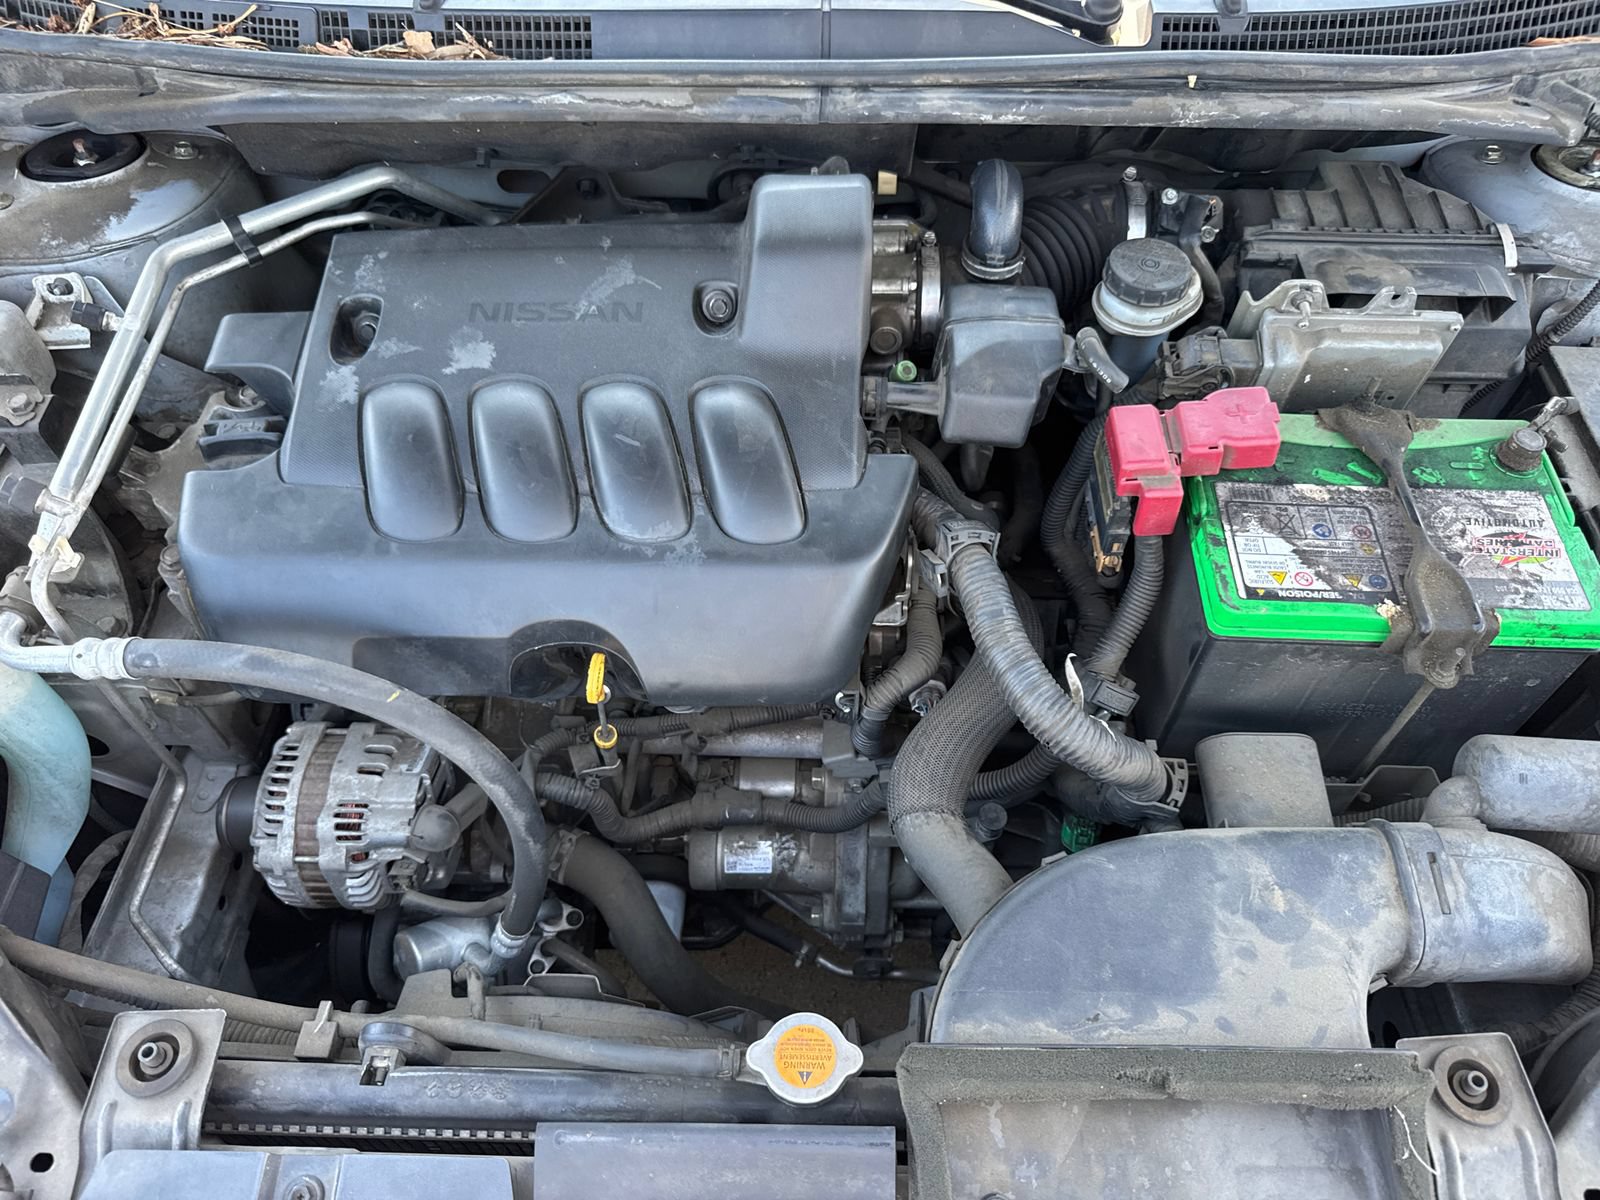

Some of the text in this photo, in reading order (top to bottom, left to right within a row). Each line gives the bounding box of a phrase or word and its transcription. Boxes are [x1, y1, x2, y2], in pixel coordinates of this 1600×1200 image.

[468, 302, 643, 322] NISSAN
[1464, 517, 1545, 528] AUTOMOTIVE
[1474, 547, 1560, 557] INTERSTATE
[783, 1061, 826, 1070] WARNING
